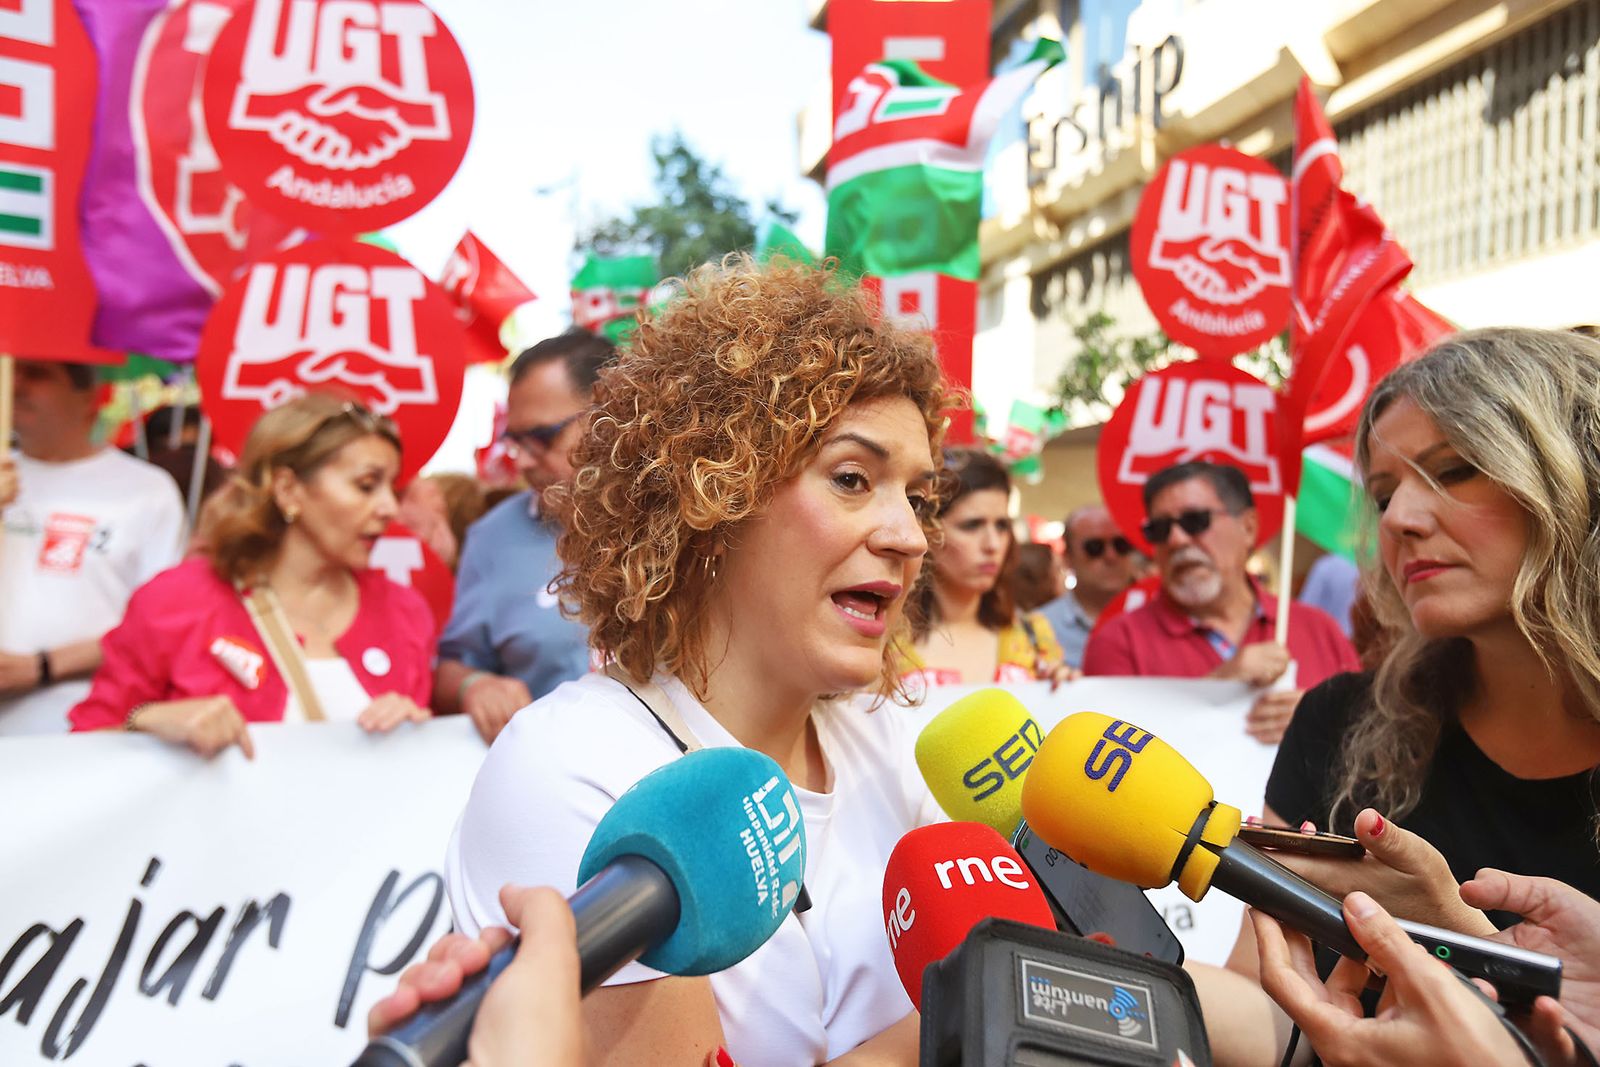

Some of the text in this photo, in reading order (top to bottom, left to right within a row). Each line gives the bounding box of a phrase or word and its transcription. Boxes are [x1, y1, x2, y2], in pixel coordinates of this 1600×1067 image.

[240, 0, 437, 98] UGT
[267, 166, 413, 209] Andalucía
[1158, 160, 1287, 253] UGT
[234, 264, 426, 357] UGT
[1169, 298, 1265, 336] Andalucía
[1131, 377, 1277, 464] UGT
[1084, 720, 1156, 792] SE
[740, 828, 768, 906] HUELVA
[934, 856, 1030, 889] rne
[887, 887, 916, 961] ne
